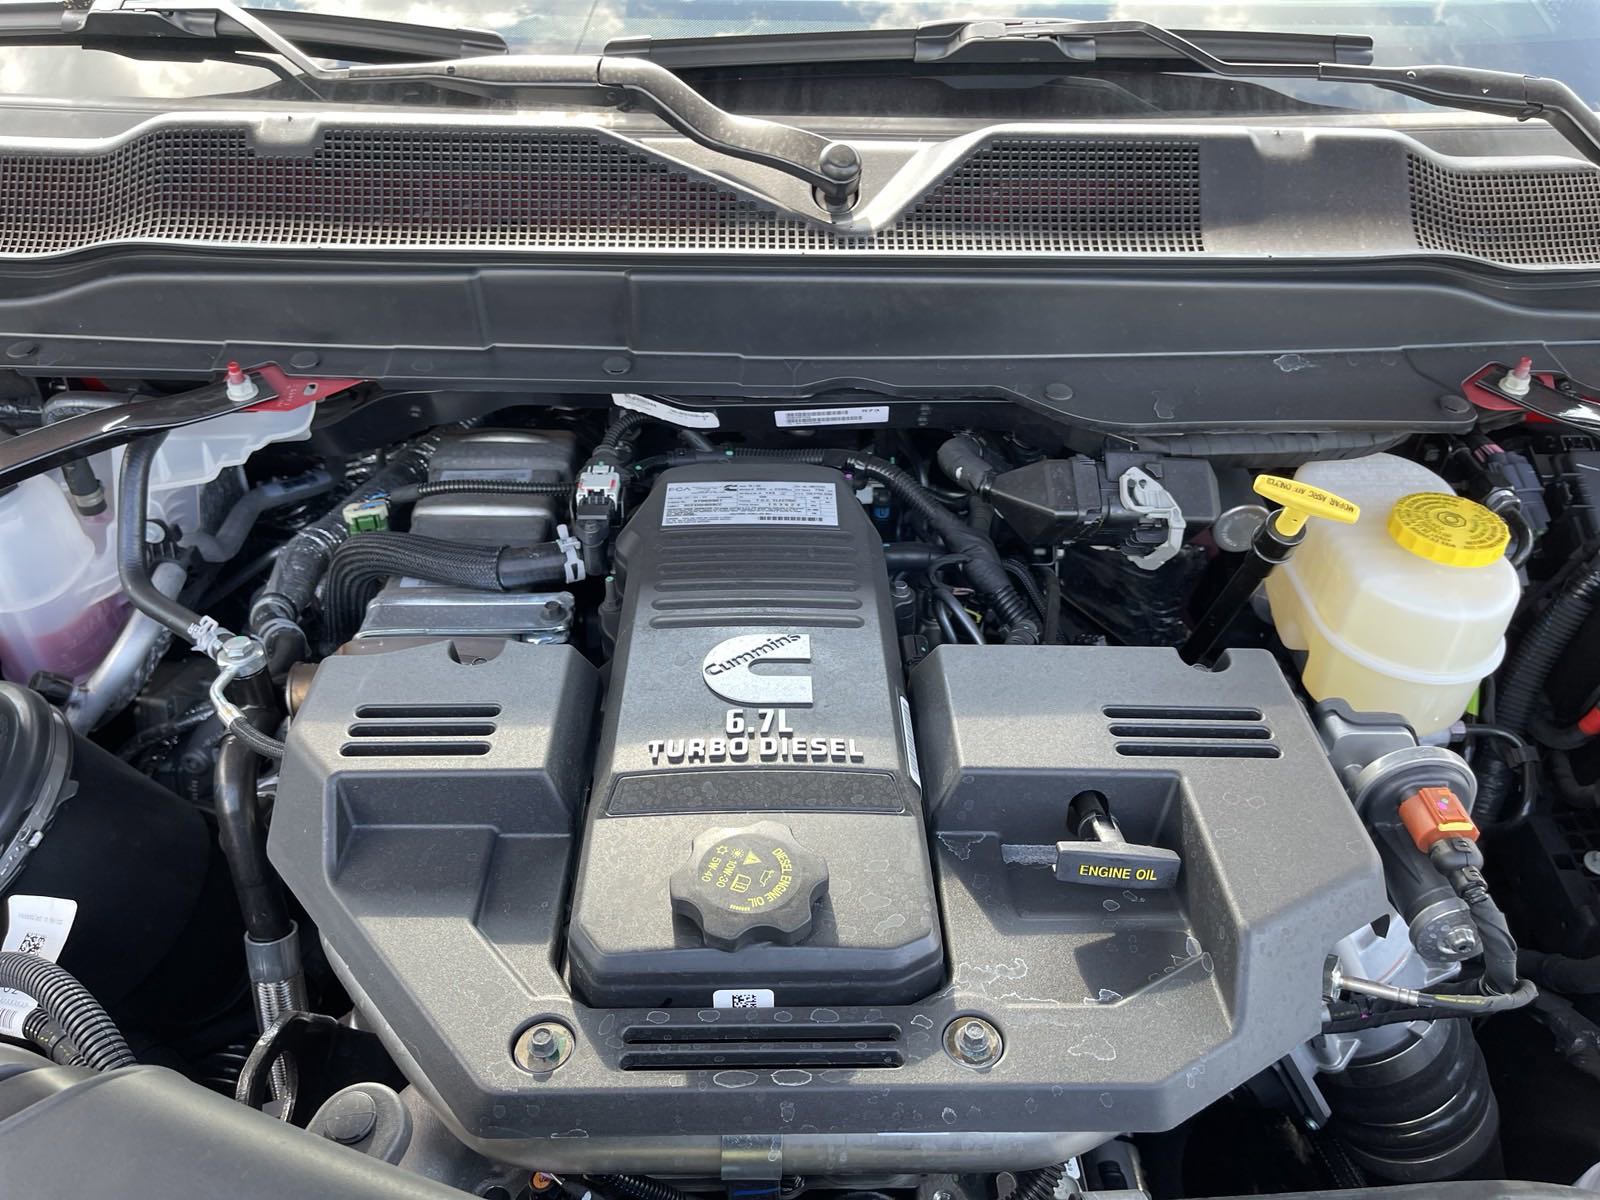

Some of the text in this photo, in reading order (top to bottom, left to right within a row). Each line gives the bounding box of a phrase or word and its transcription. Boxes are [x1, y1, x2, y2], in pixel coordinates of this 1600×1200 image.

[704, 633, 801, 676] Cummins
[725, 708, 793, 739] 6.7L
[648, 737, 864, 765] TURBO DIESEL
[701, 856, 722, 882] 5W-40
[715, 859, 737, 888] 10W-30
[747, 847, 793, 908] DIESEL ENGINE OIL
[1079, 864, 1157, 881] ENGINE OIL
